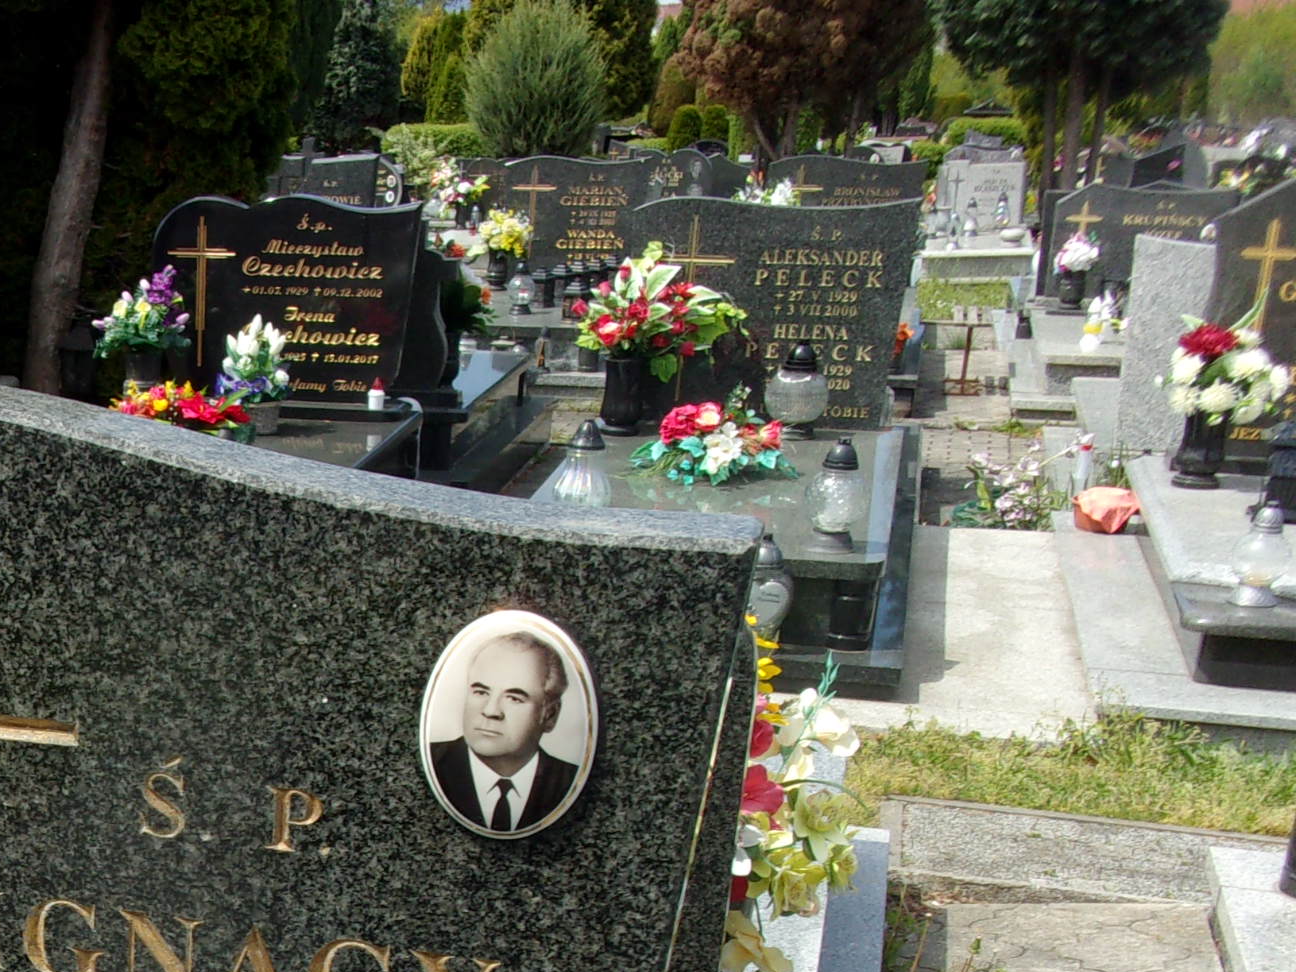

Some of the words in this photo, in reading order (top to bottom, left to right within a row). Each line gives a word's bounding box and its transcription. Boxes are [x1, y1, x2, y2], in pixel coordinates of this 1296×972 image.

[567, 229, 615, 239] WANDA
[759, 249, 883, 266] ALEKSANDER
[242, 255, 384, 279] Czechowicz
[754, 268, 883, 288] PELECK
[829, 291, 858, 303] 1929
[284, 306, 336, 323] Irena
[773, 323, 849, 340] HELENA
[1229, 426, 1263, 441] JEZ
